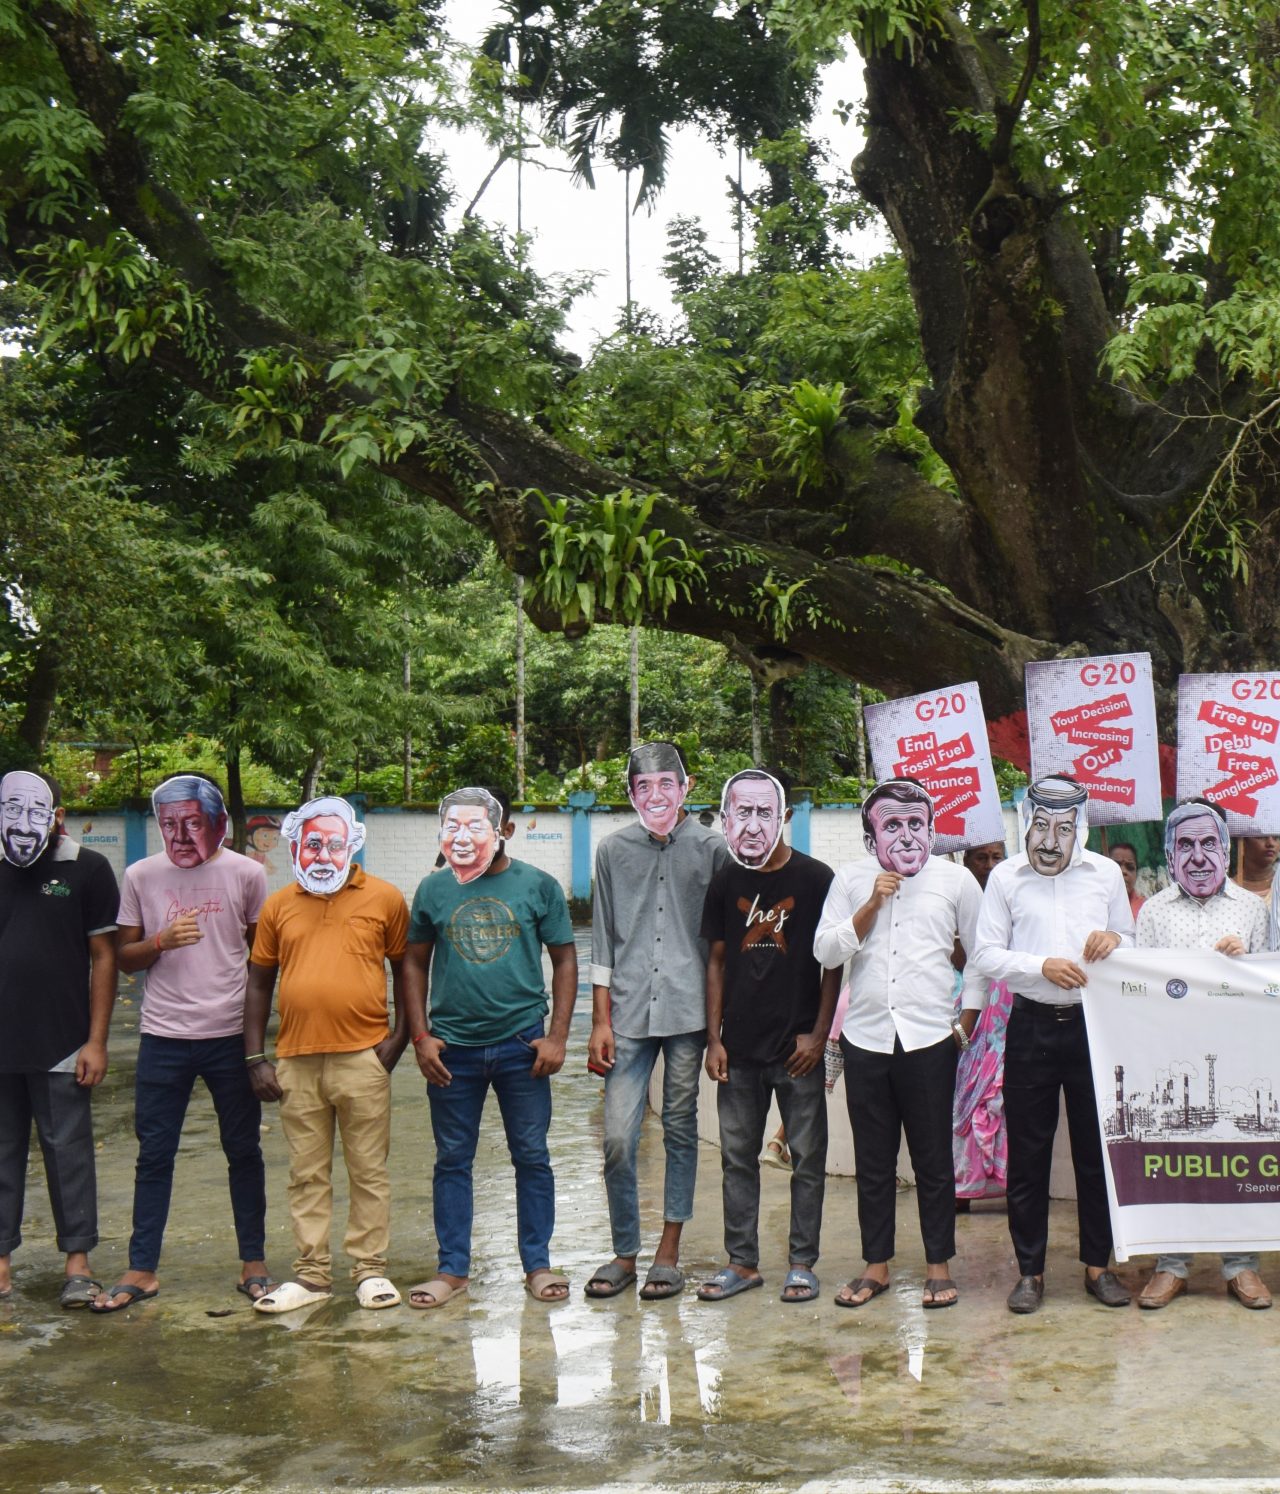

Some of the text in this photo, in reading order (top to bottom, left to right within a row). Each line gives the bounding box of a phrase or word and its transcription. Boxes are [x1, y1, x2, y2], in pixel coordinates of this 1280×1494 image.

[1080, 662, 1136, 687] G20
[915, 693, 966, 721] G20
[1054, 699, 1129, 727] Your Decision
[1211, 704, 1274, 735] Free up
[904, 735, 935, 753] End
[1072, 728, 1130, 744] Increasing
[1210, 734, 1250, 752] Debt
[901, 741, 966, 777] Fossil Fuel
[1083, 748, 1114, 770] Our
[1228, 758, 1260, 771] Free
[1206, 767, 1276, 803] Bangladesh
[82, 835, 118, 843] BERGER
[526, 832, 563, 840] BERGER
[1144, 1154, 1250, 1178] PUBLIC
[1236, 1183, 1243, 1193] 7
